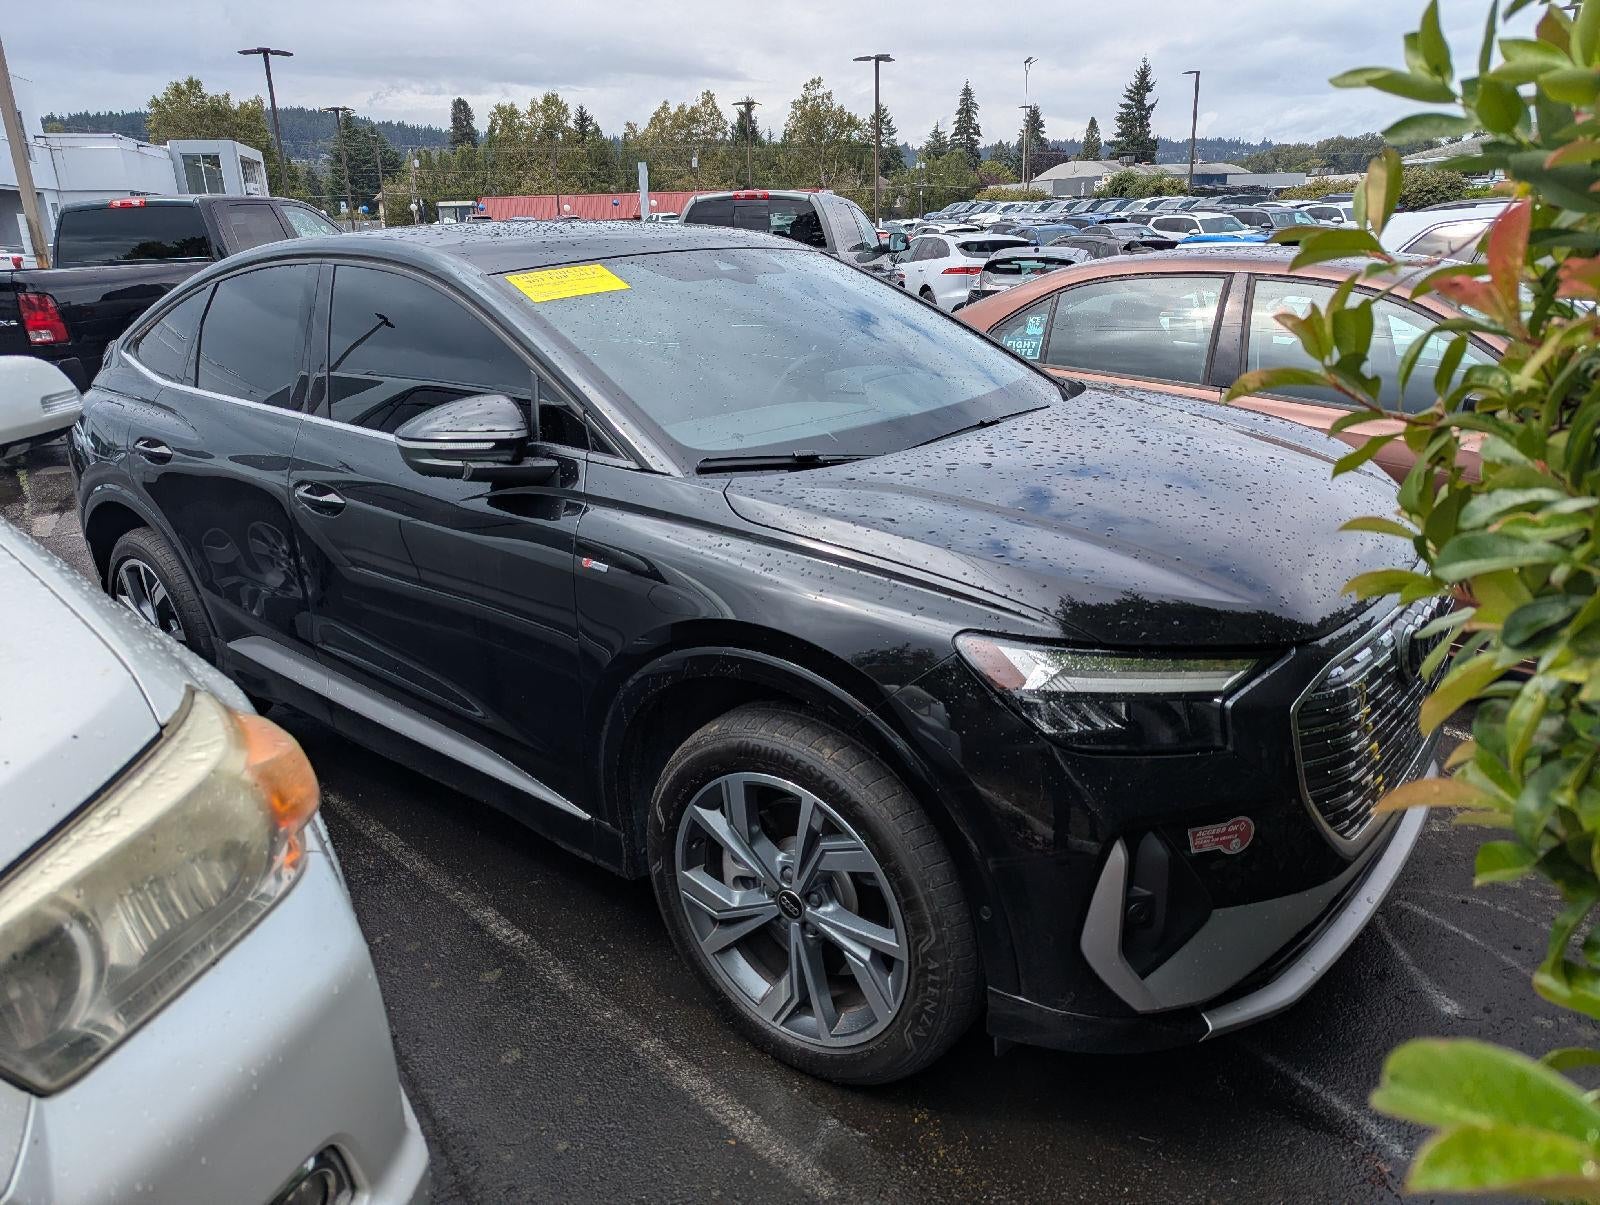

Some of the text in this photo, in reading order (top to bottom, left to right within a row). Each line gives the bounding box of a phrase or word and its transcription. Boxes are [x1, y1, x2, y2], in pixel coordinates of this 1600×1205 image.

[1006, 340, 1038, 349] FIGHT
[1013, 348, 1034, 356] ATE
[1196, 824, 1240, 836] ACCESS OK
[914, 957, 940, 1037] ALENZA
